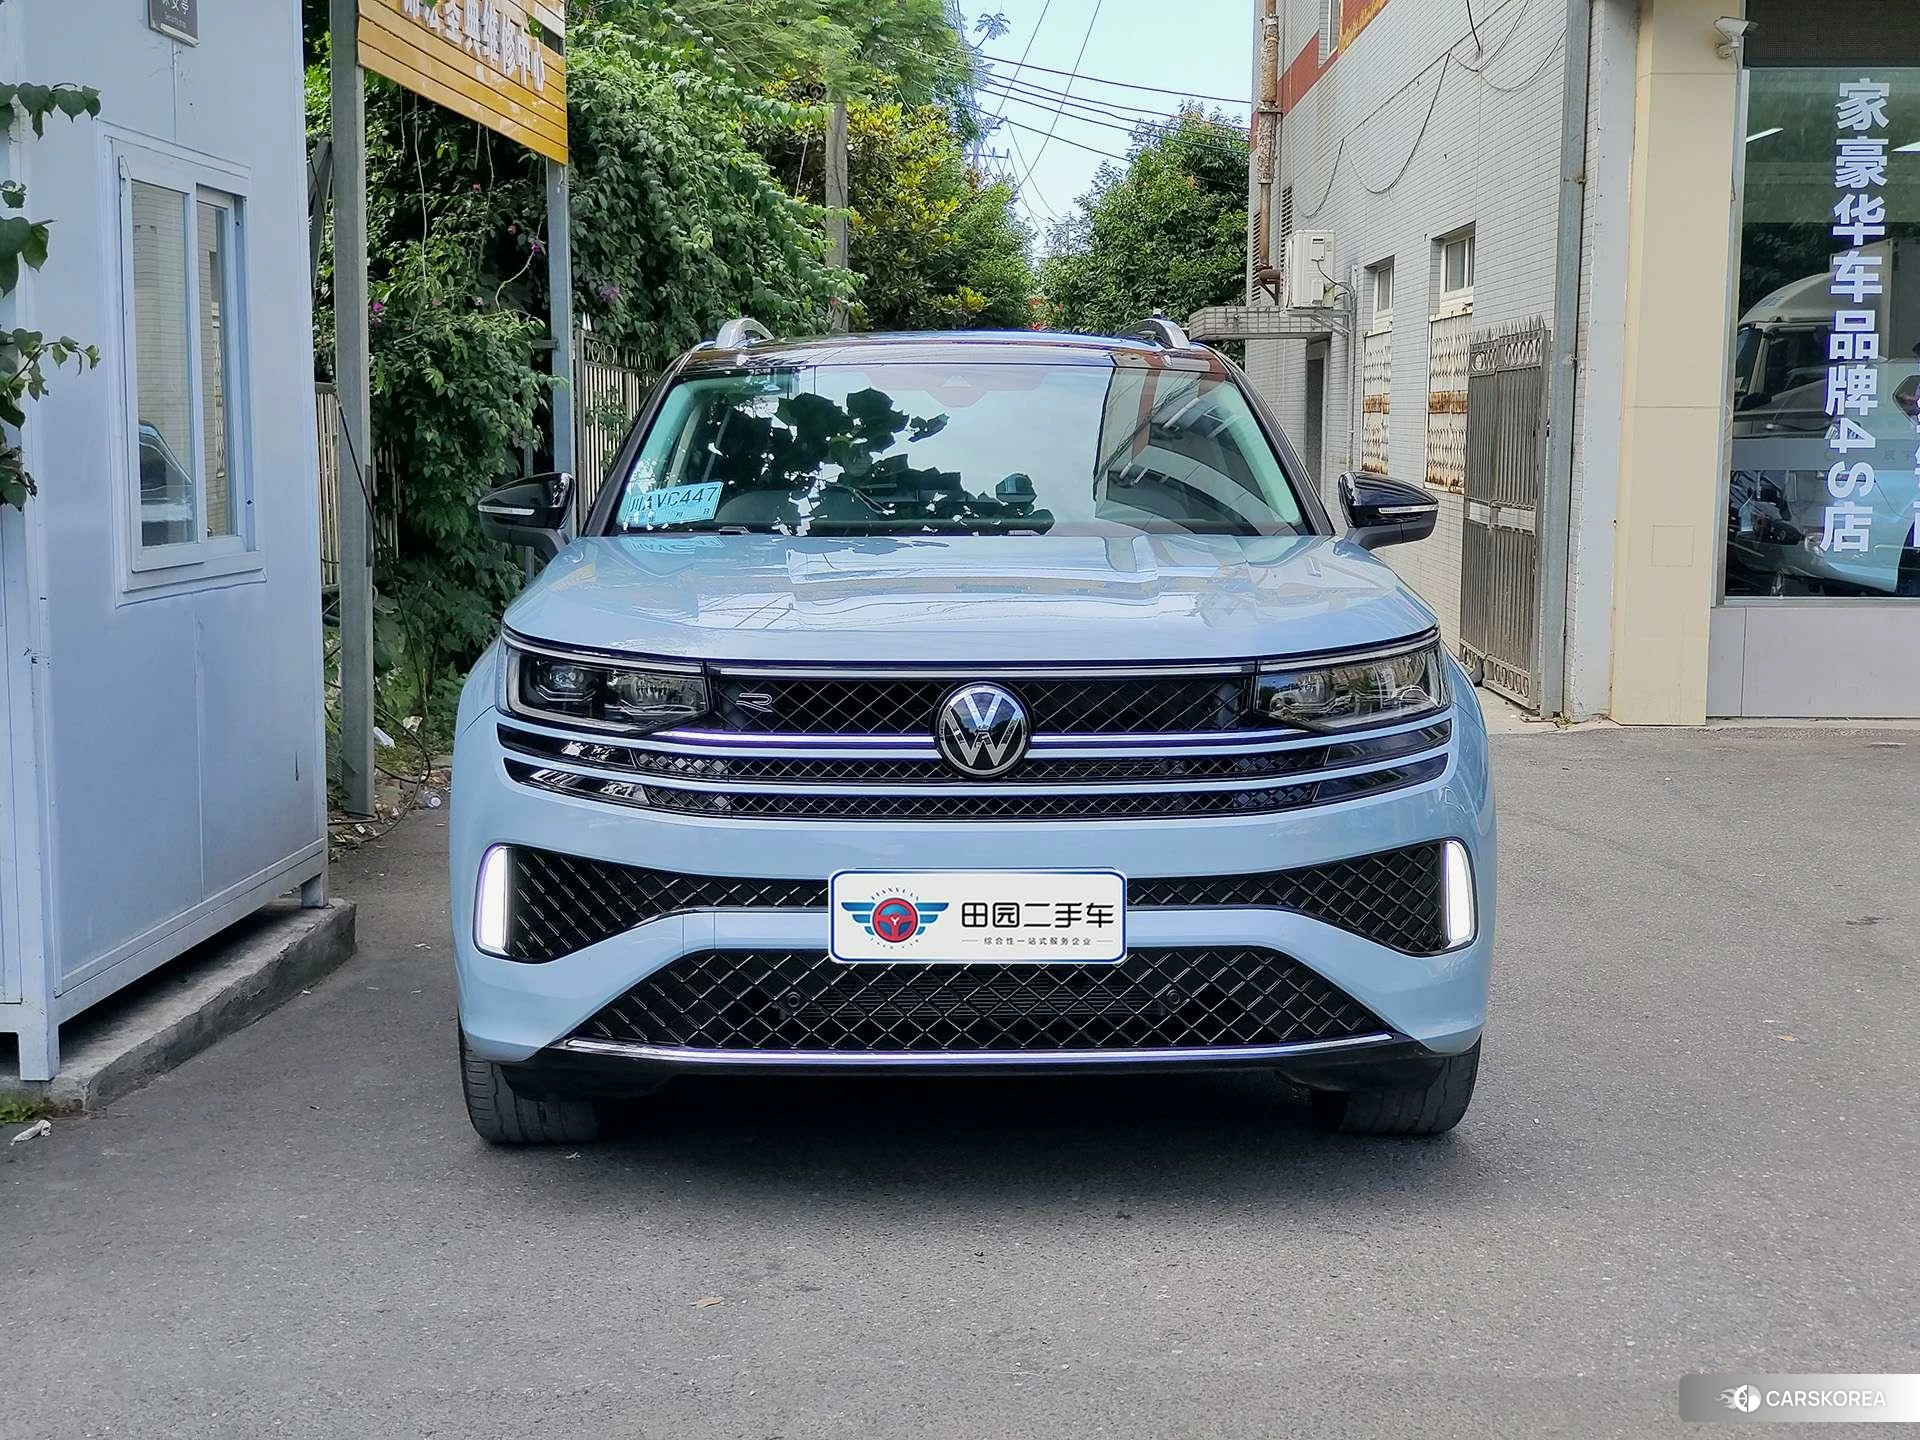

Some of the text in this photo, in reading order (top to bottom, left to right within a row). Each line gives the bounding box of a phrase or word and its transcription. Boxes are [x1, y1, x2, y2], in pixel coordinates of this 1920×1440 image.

[1820, 78, 1890, 553] 家豪华车品牌4S店
[961, 902, 1114, 928] 田园二手车
[983, 936, 1092, 946] 综合性一站式服务企业
